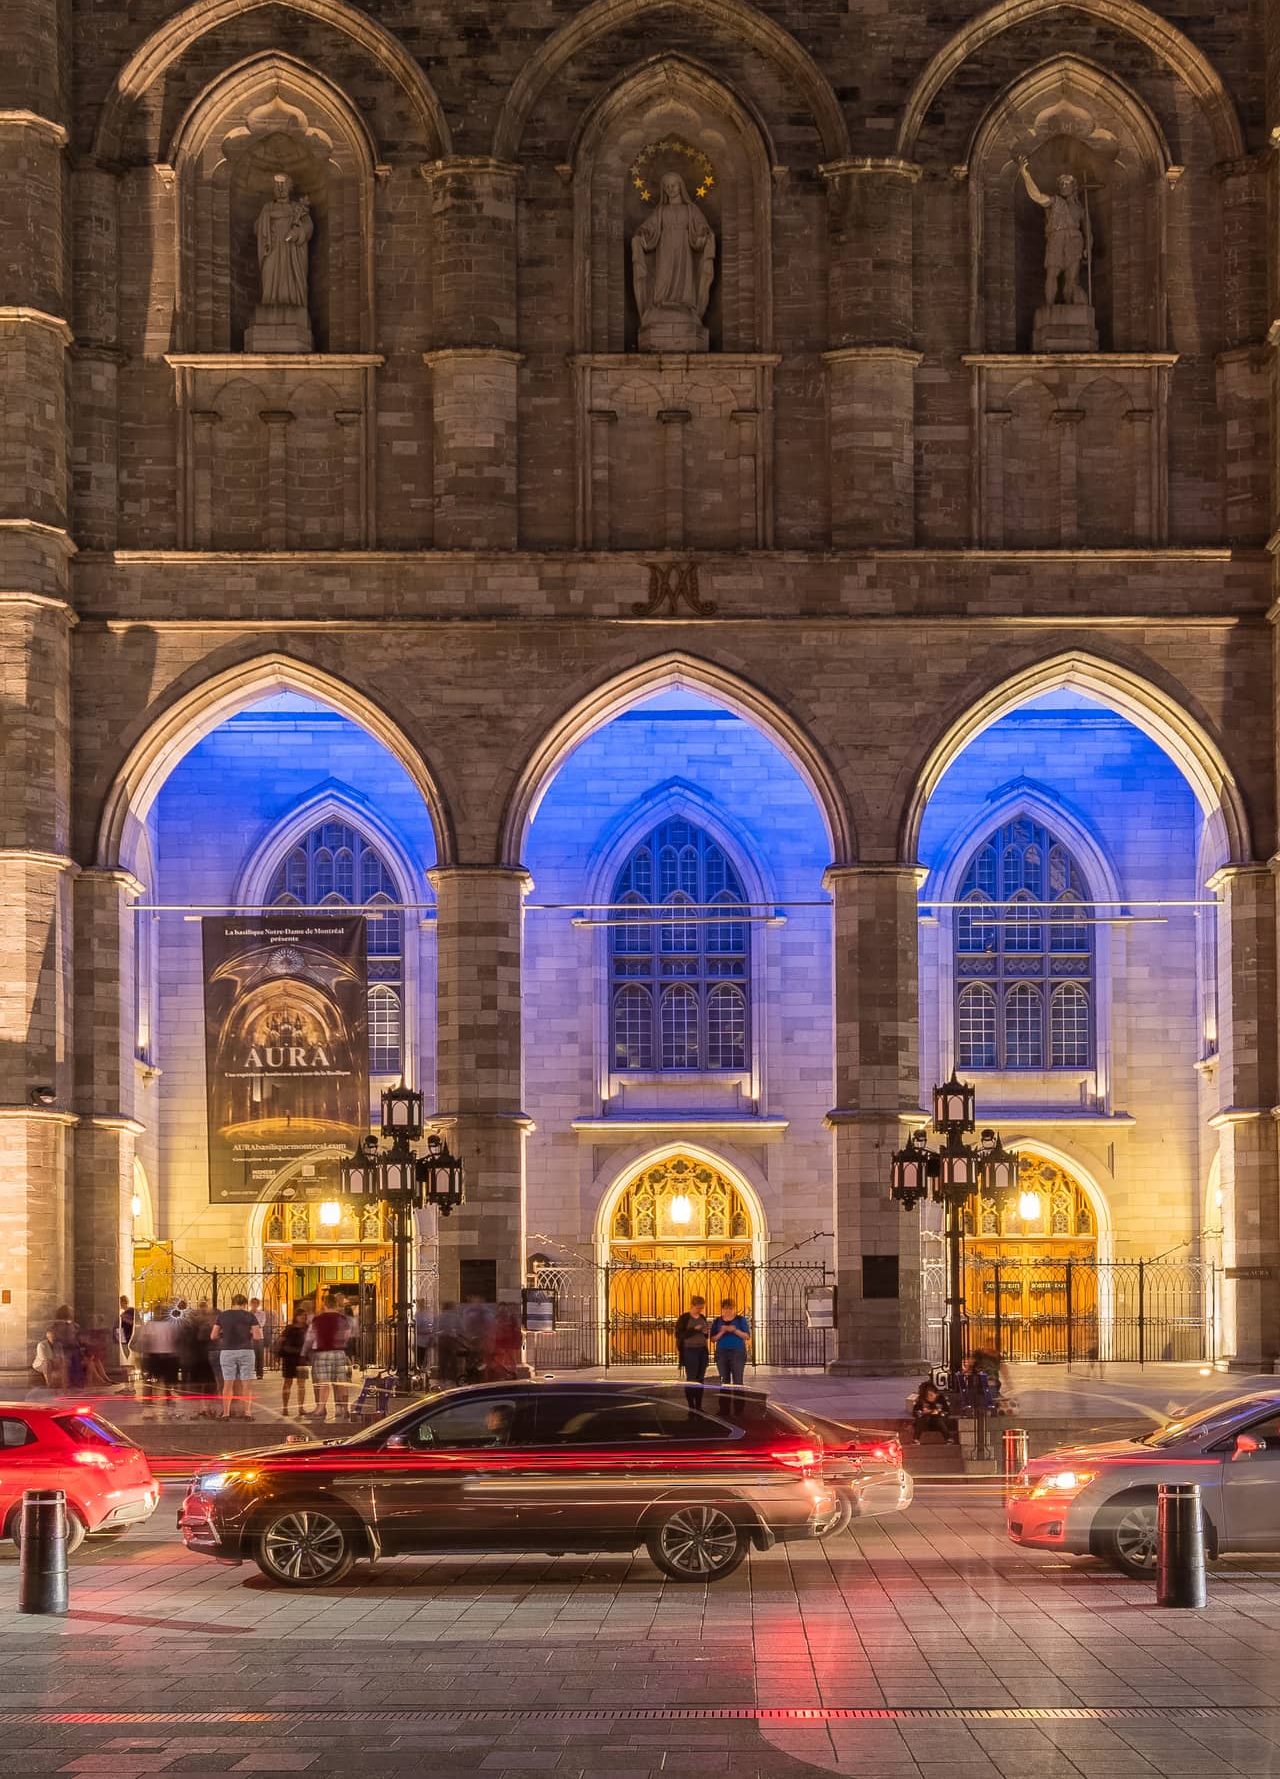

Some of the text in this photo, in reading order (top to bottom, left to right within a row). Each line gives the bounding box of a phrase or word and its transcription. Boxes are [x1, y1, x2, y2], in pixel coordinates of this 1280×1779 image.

[235, 928, 264, 937] basilique
[305, 927, 313, 935] de
[314, 927, 345, 935] Montréal
